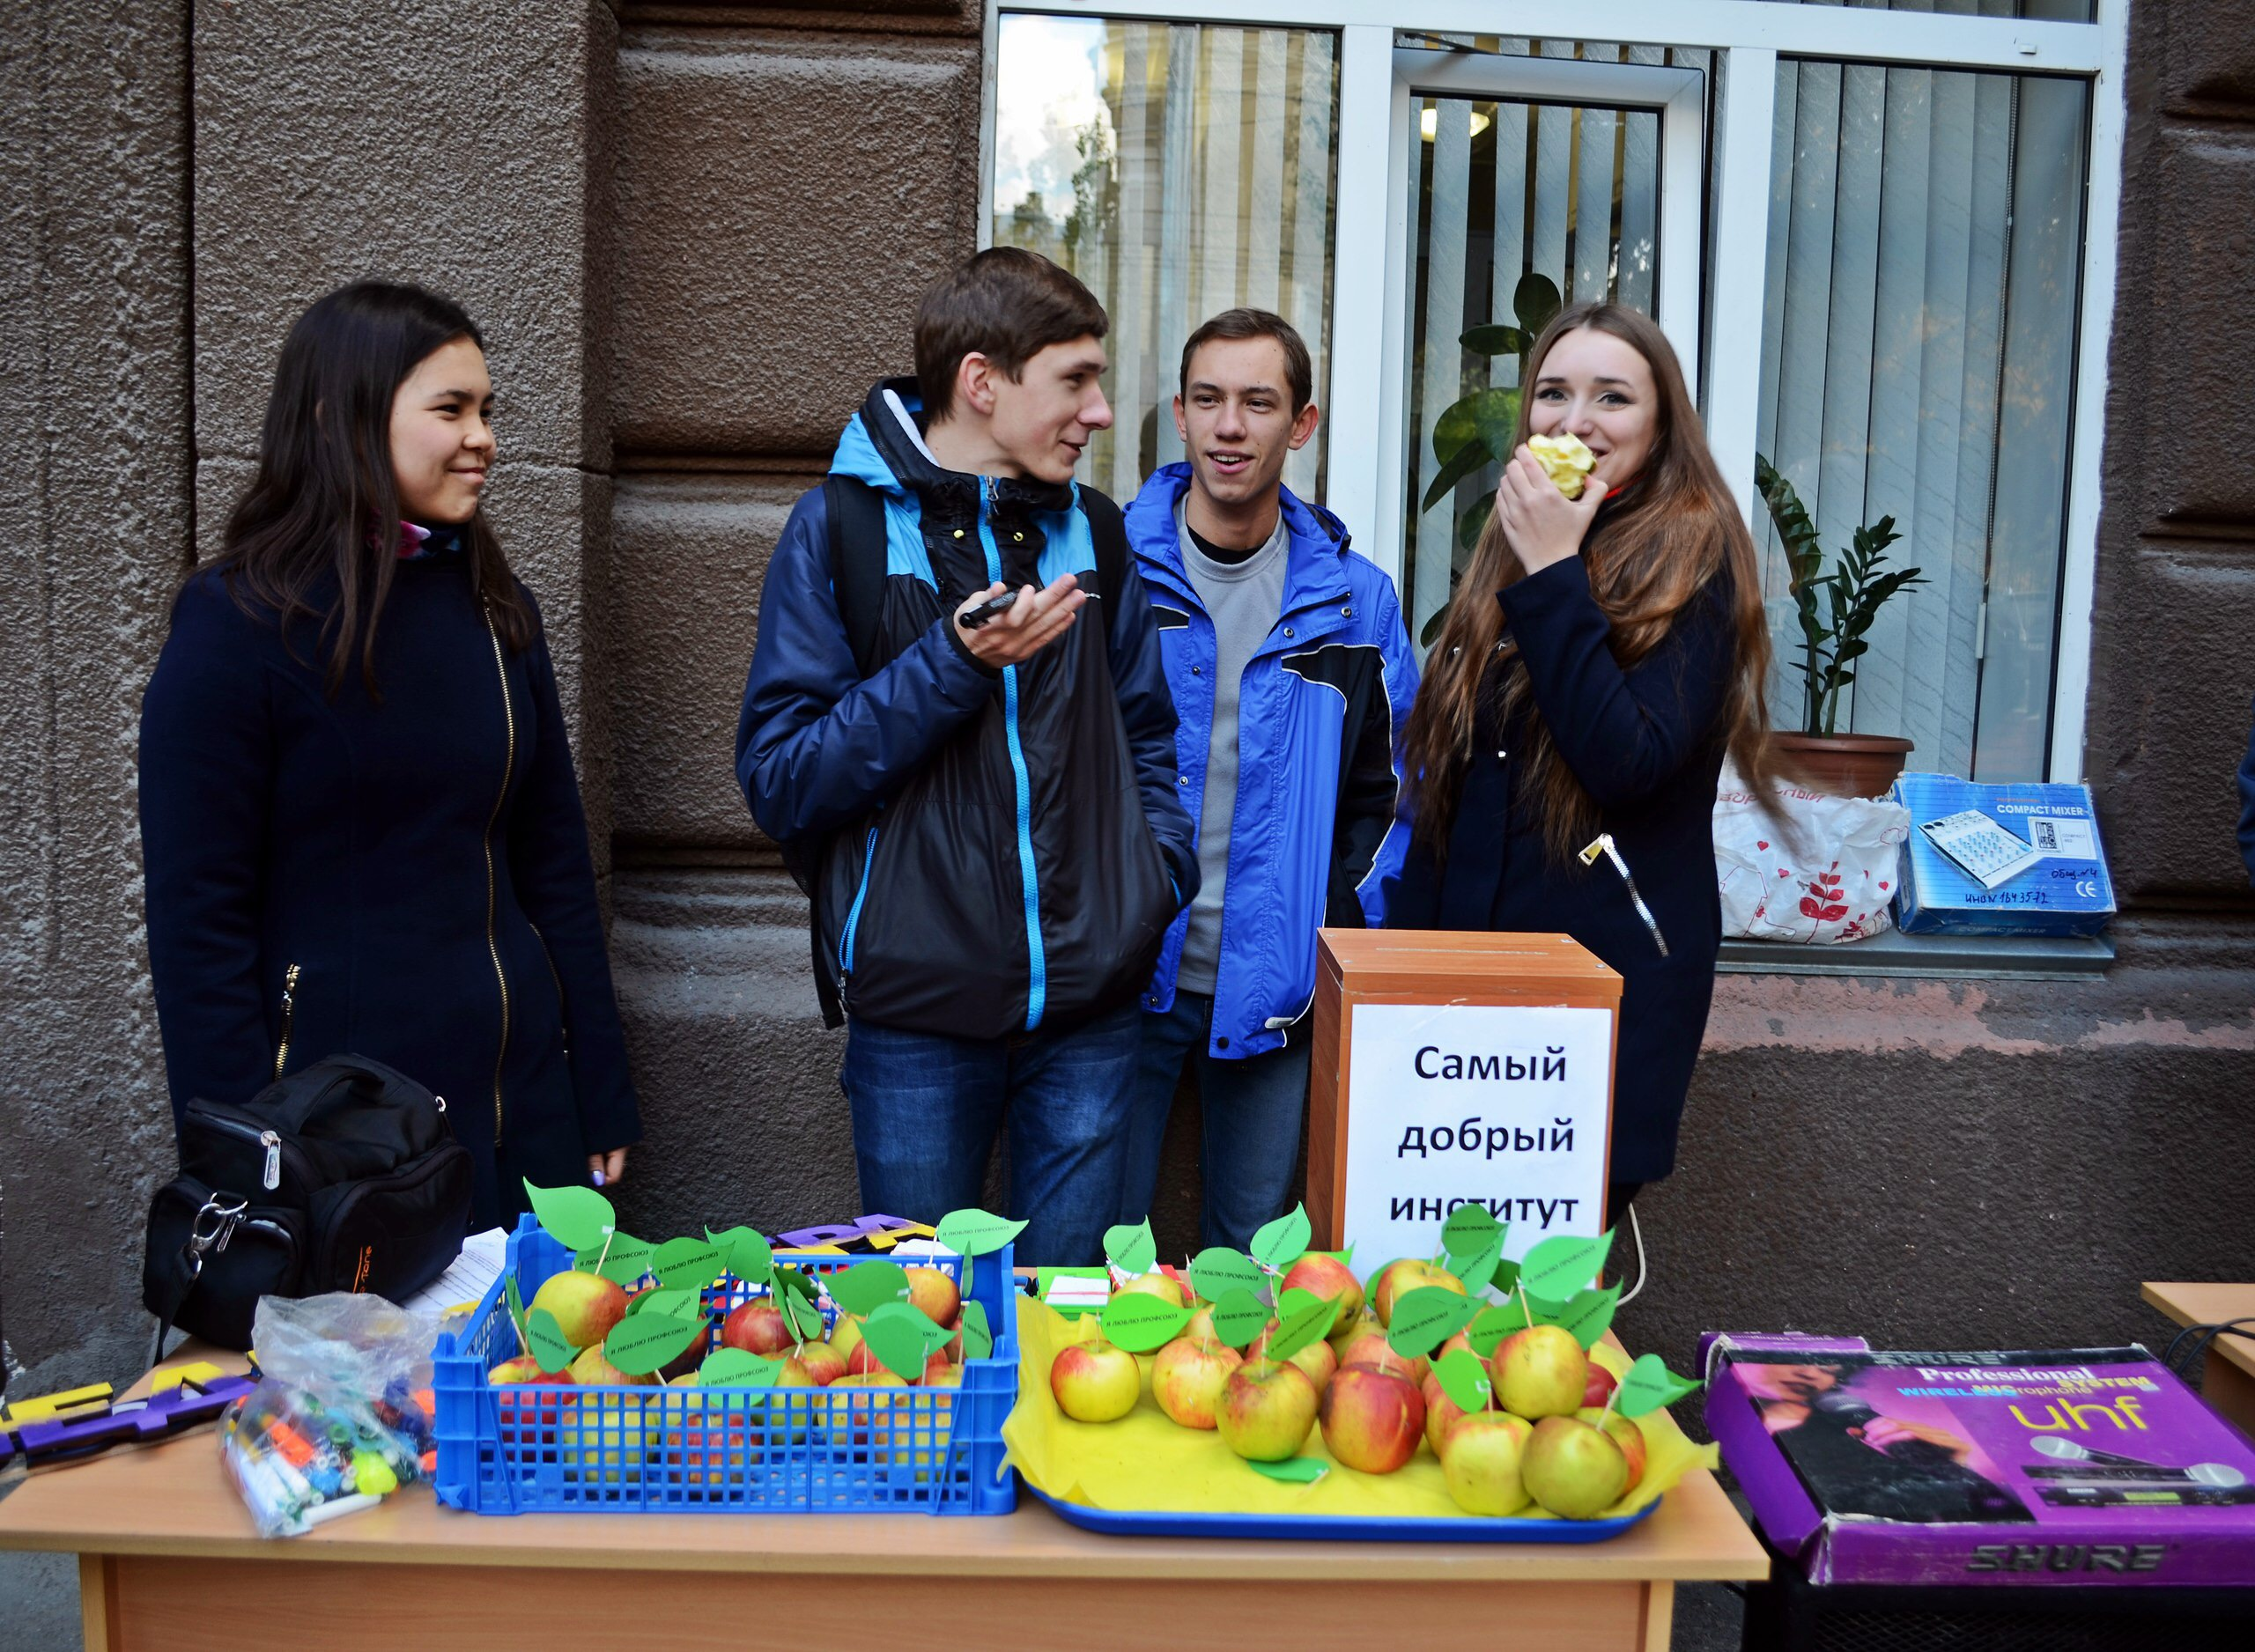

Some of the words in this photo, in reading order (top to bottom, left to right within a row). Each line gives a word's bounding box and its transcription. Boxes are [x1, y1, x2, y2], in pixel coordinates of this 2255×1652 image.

[1996, 804, 2050, 815] COMPACT
[2051, 806, 2084, 815] MIXER
[2075, 881, 2097, 898] CE
[1415, 1045, 1565, 1081] Самый
[1398, 1117, 1573, 1160] добрый
[612, 1250, 649, 1262] ПРОФСОЮЗ
[664, 1261, 686, 1273] ЛЮБЛЮ
[687, 1251, 719, 1265] ПРОФСОЮЗ
[1224, 1272, 1259, 1281] ПРОФСОЮЗ
[669, 1295, 691, 1317] ОФСОЮЗ
[1113, 1317, 1139, 1326] ЛЮБЛЮ
[1141, 1313, 1178, 1323] ПРОФСОЮЗ
[617, 1339, 646, 1353] ЛЮБЛЮ
[647, 1326, 688, 1342] ПРОФСОЮЗ
[711, 1375, 735, 1386] ЛЮБЛЮ
[736, 1366, 769, 1380] ПРОФСОЮЗ
[1915, 1366, 2097, 1382] Professional
[2057, 1375, 2152, 1388] SYSTEM
[2007, 1396, 2148, 1431] uhf
[1966, 1544, 2166, 1573] SHURE
